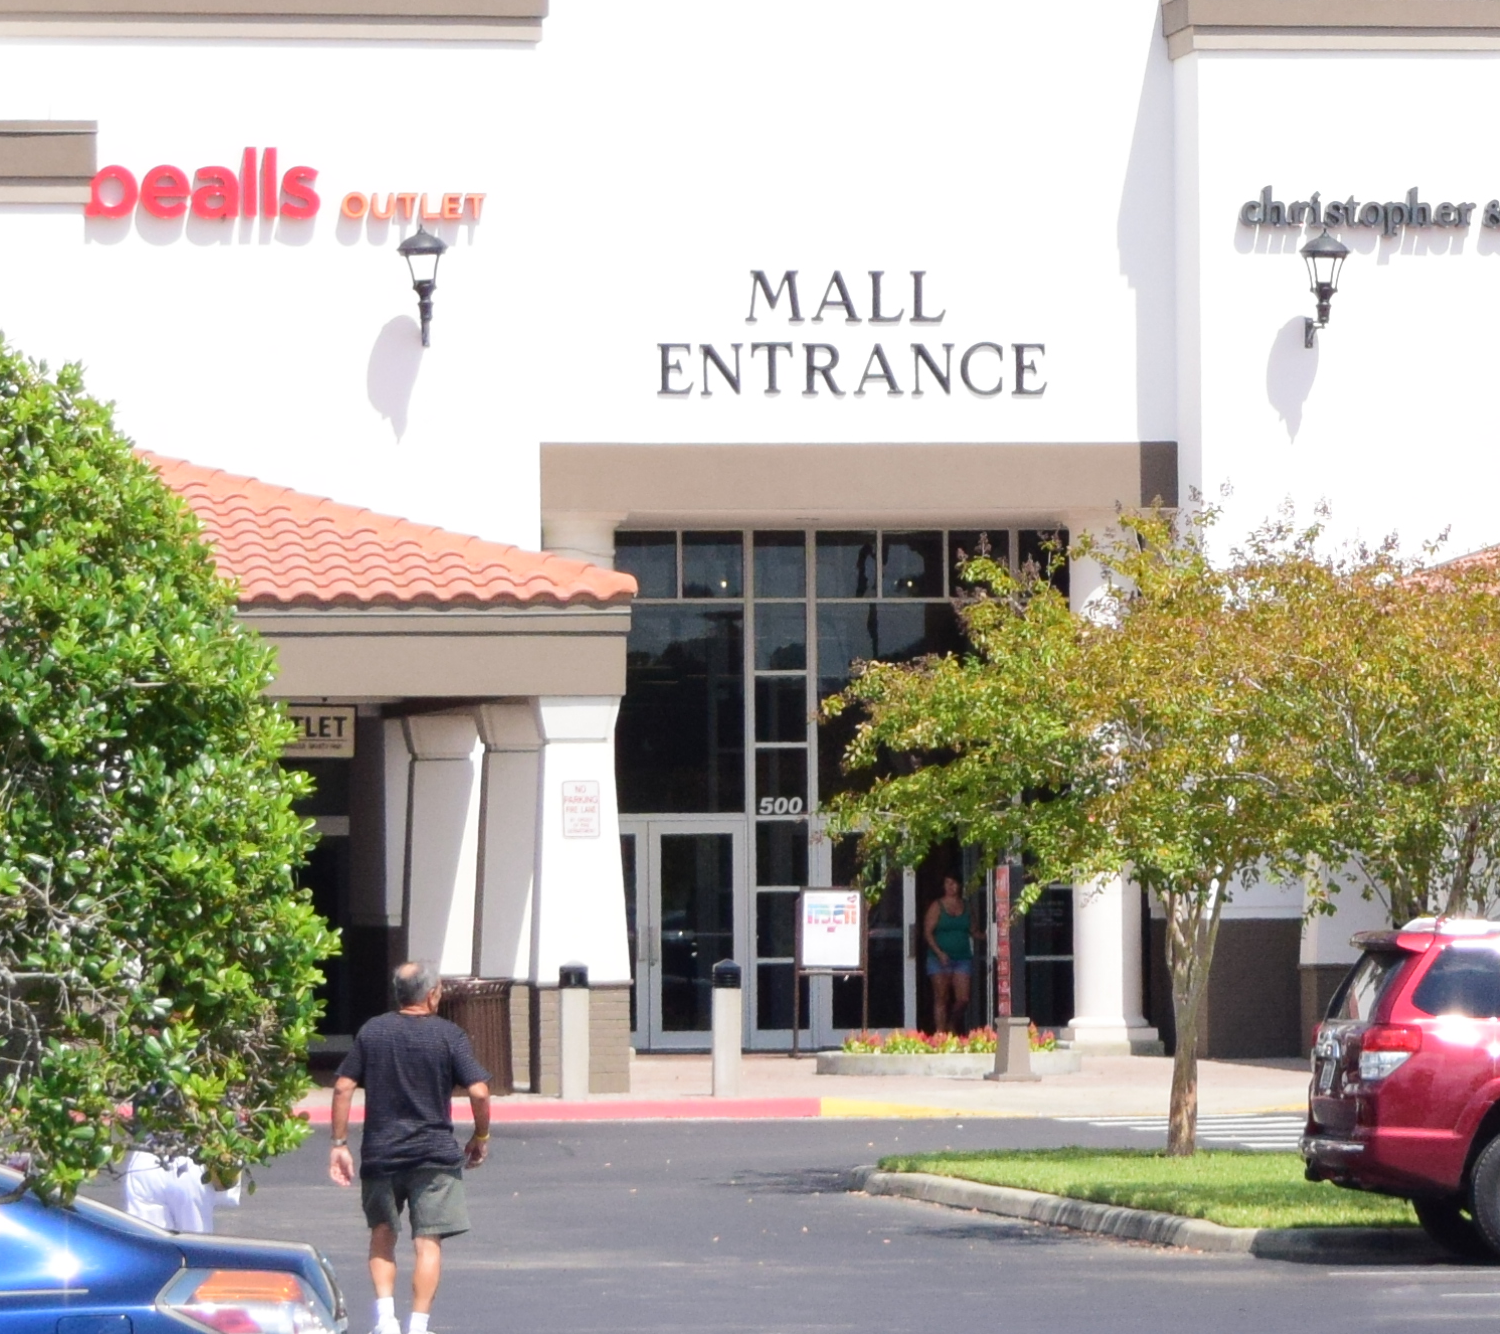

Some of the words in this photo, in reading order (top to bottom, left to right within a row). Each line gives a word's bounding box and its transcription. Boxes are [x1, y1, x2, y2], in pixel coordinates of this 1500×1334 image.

[85, 146, 321, 220] bealls
[341, 191, 487, 220] OUTLET
[1240, 184, 1476, 238] christopher
[744, 269, 947, 323] MALL
[656, 341, 1048, 396] ENTRANCE
[288, 715, 347, 738] TLET
[759, 796, 803, 815] 500
